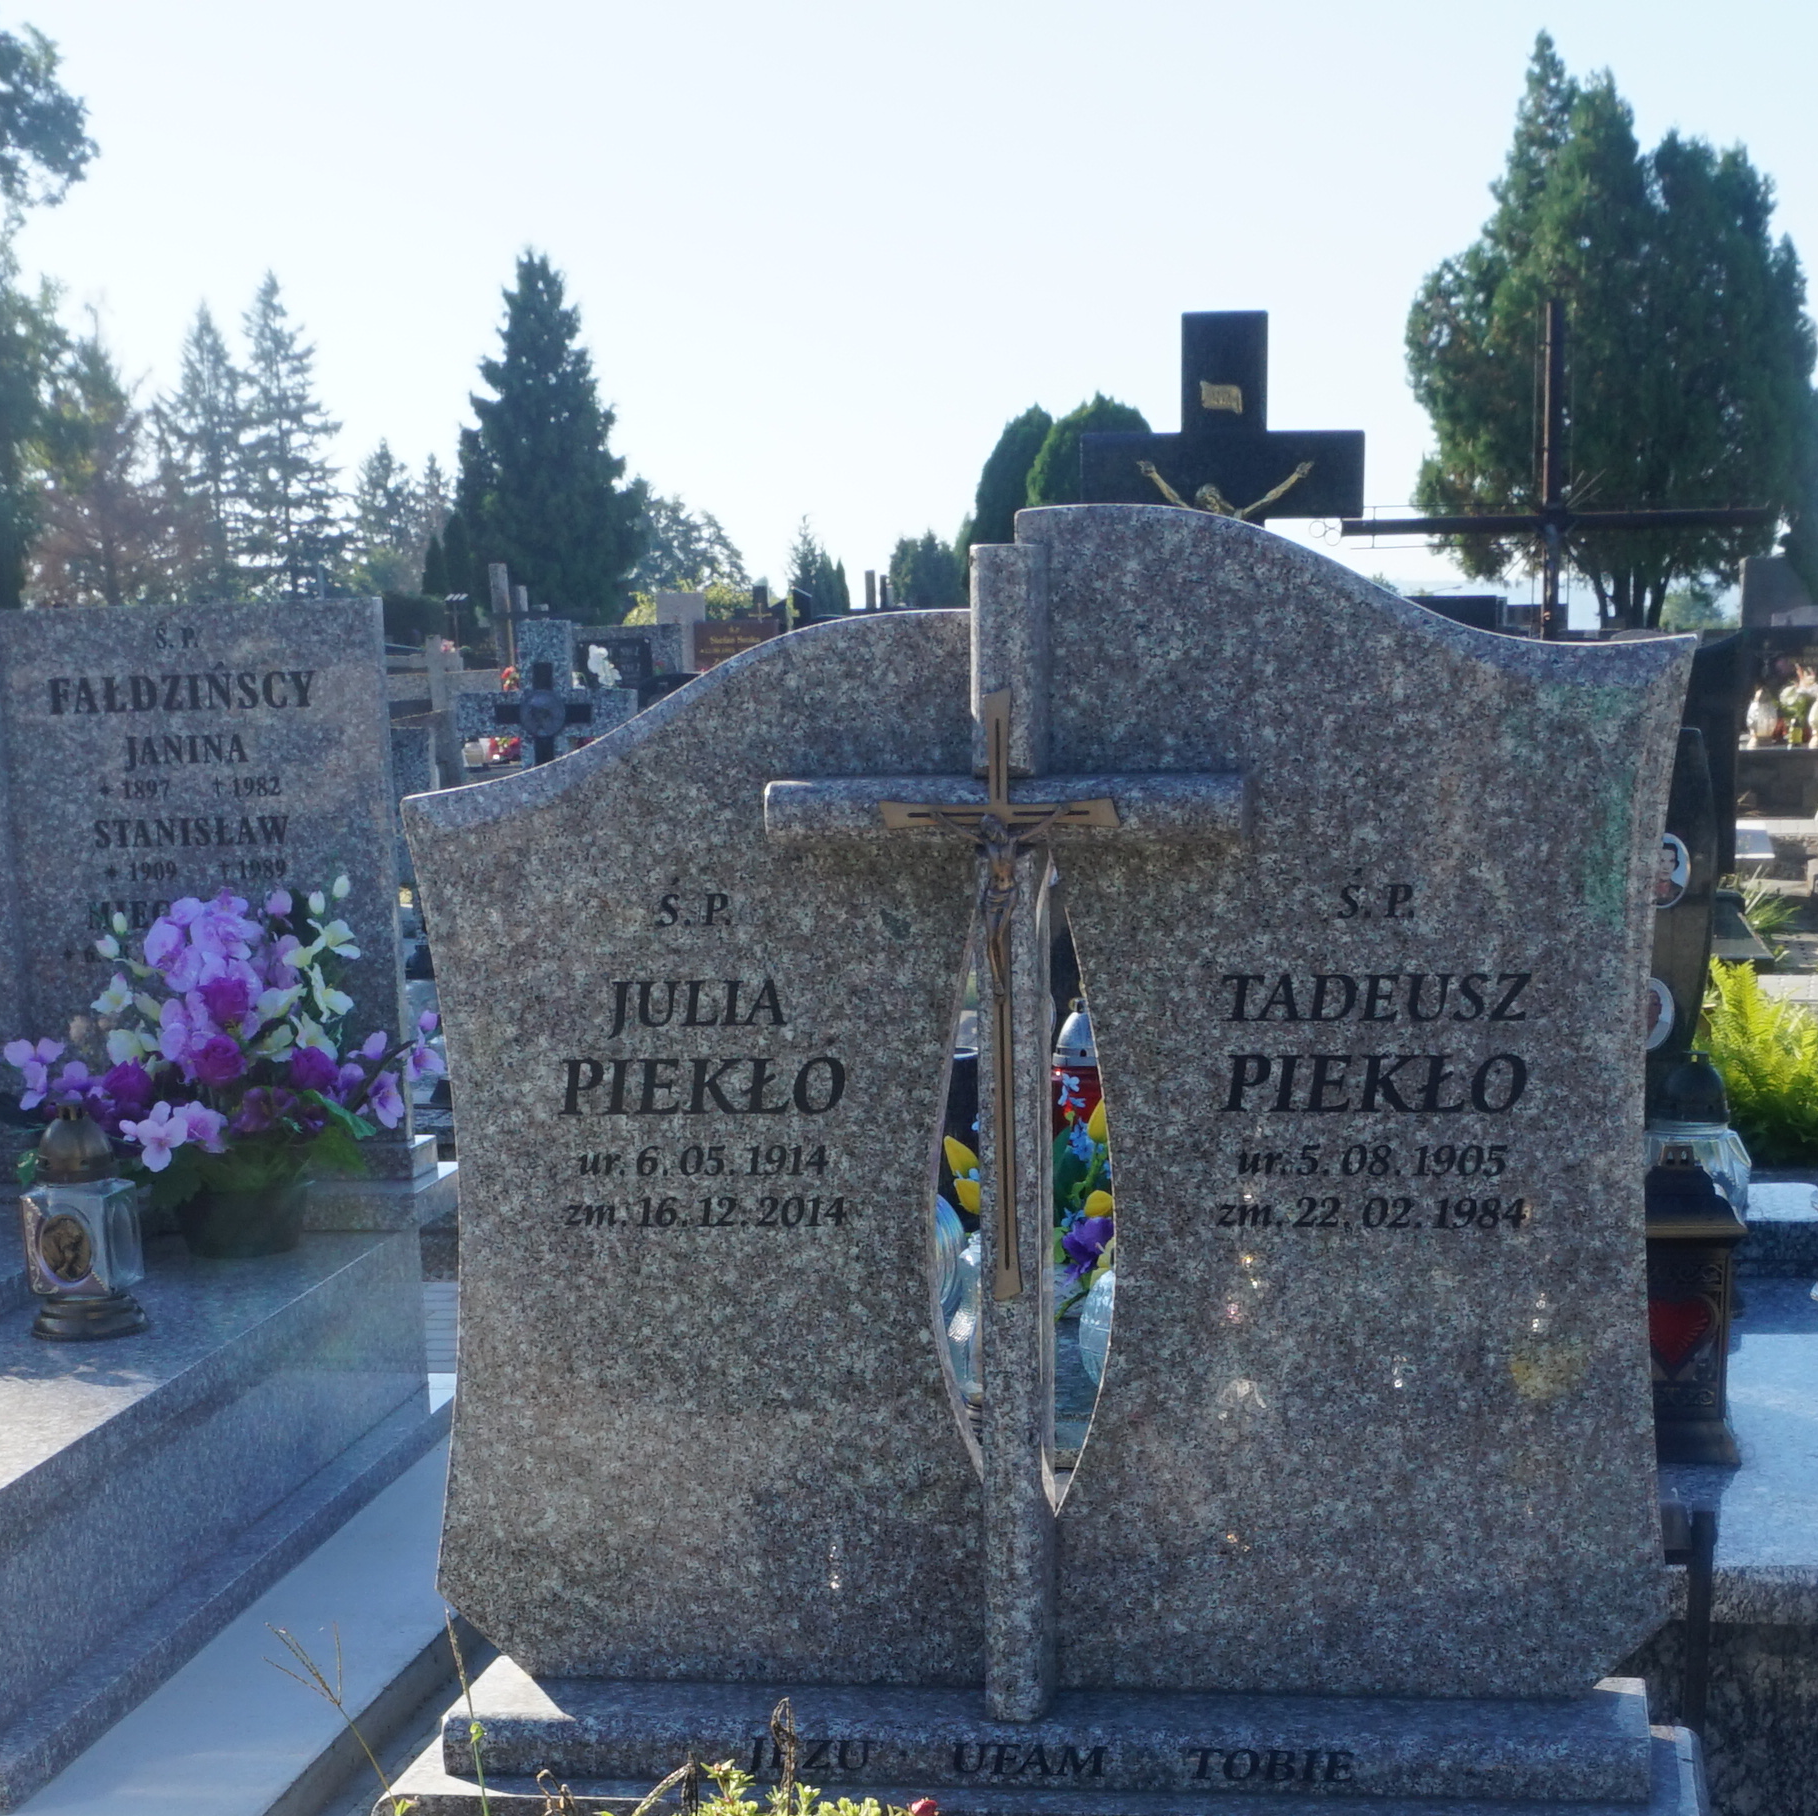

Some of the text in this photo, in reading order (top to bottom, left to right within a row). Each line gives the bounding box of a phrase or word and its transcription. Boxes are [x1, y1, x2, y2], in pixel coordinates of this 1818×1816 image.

[47, 661, 317, 716] FAŁDZIŃSCY
[125, 733, 250, 773] JANINA
[121, 776, 283, 801] 1897 1982
[92, 815, 291, 849] STANISŁAW
[130, 859, 288, 883] 1909 1989
[607, 978, 788, 1040] JULIA
[1221, 973, 1534, 1023] TADEUSZ
[558, 1056, 847, 1116] PIEKŁO
[1221, 1053, 1529, 1114] PIEKŁO
[576, 1154, 625, 1177] ur.
[747, 1144, 829, 1177] 1914
[1237, 1154, 1286, 1177] ur.
[1412, 1143, 1510, 1177] 1905
[565, 1204, 628, 1228] zm.
[757, 1195, 847, 1228] 2014
[1216, 1204, 1283, 1228] zm.
[1434, 1196, 1529, 1229] 1984
[951, 1740, 1108, 1778] UFAM
[1189, 1745, 1356, 1784] TOBIE
